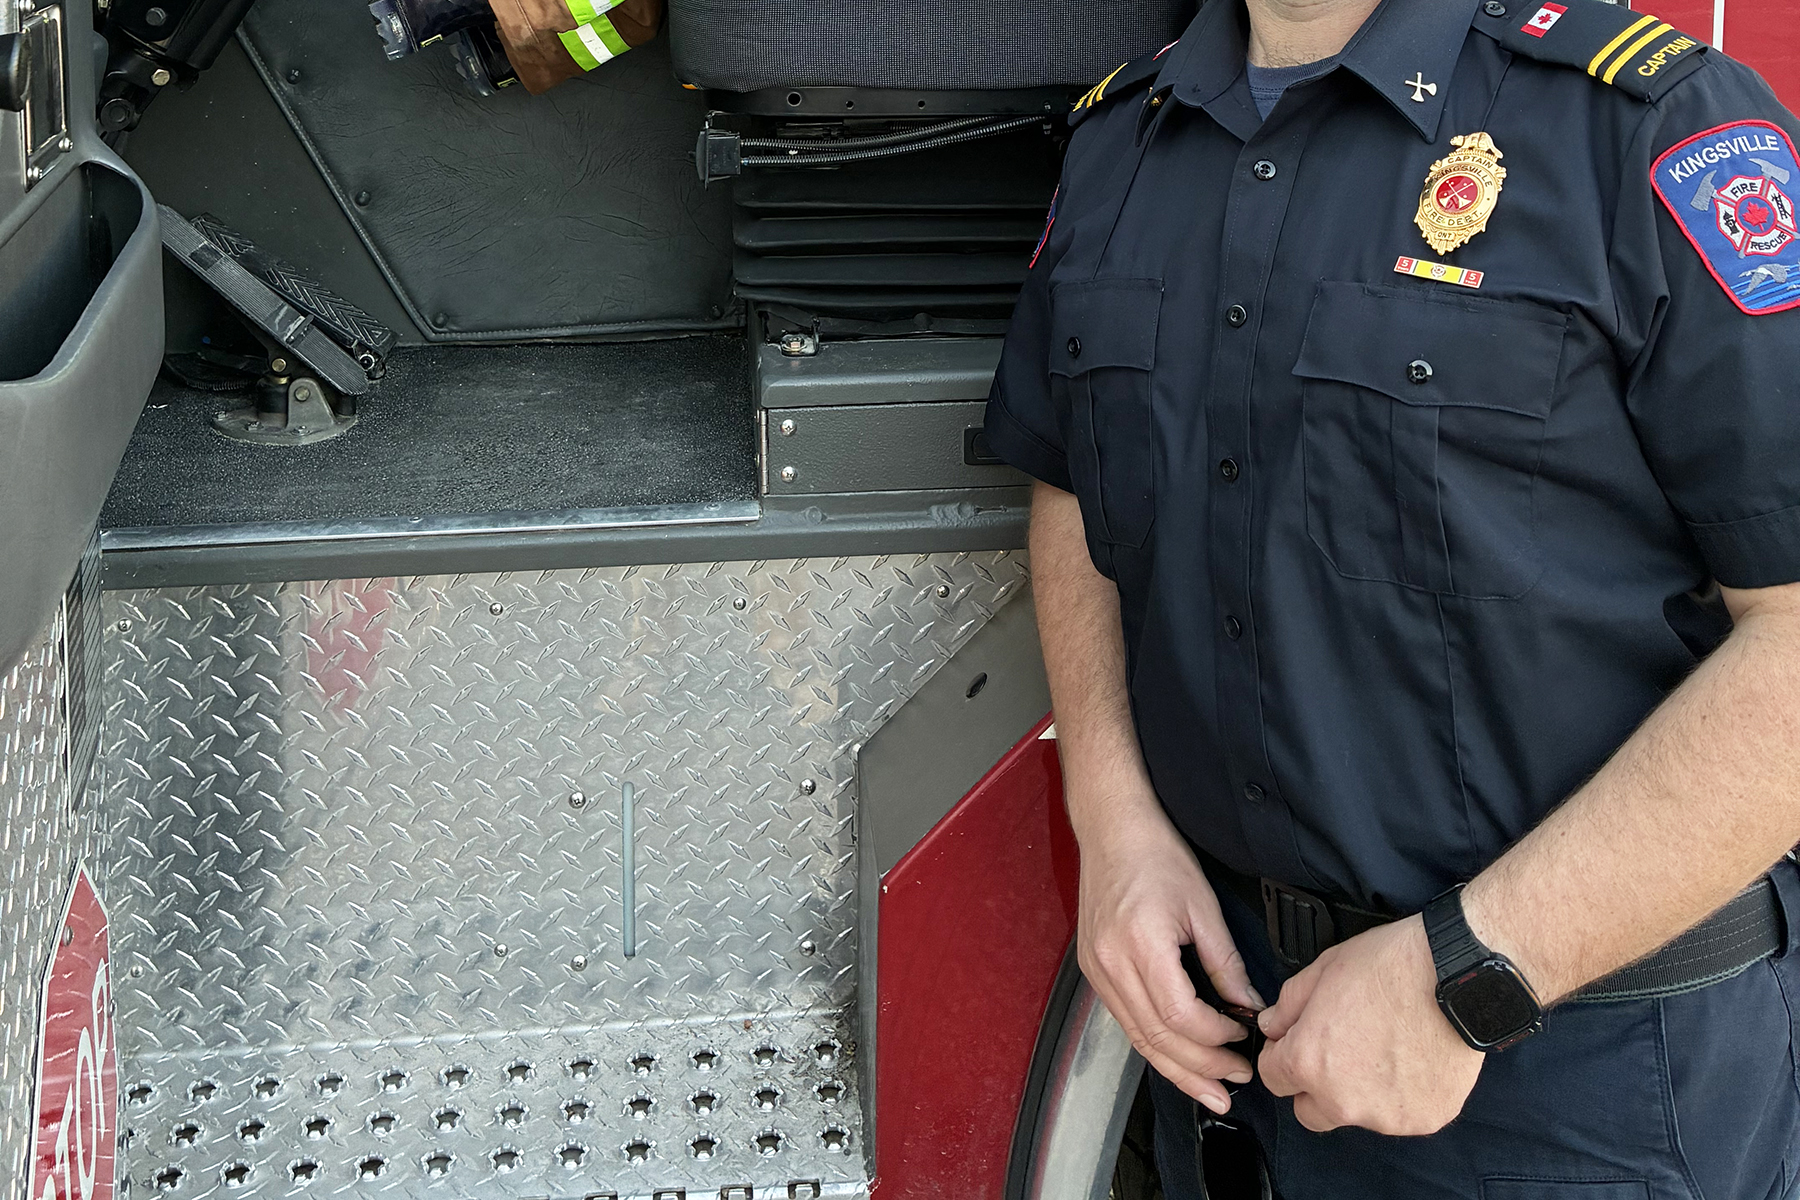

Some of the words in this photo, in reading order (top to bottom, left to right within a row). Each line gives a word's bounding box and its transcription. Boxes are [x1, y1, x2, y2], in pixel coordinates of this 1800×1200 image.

[1637, 36, 1697, 77] CAPTAIN
[1447, 155, 1494, 169] CAPTAIN
[1668, 134, 1780, 184] KINGSVILLE
[1434, 165, 1493, 188] KINGSVILLE
[1730, 182, 1758, 198] FIRE
[1423, 202, 1443, 224] FIRE
[1437, 231, 1452, 239] ONT
[1750, 230, 1787, 251] RESCUE
[1401, 259, 1409, 267] 5
[1468, 273, 1477, 281] 5
[43, 957, 108, 1200] TOP
